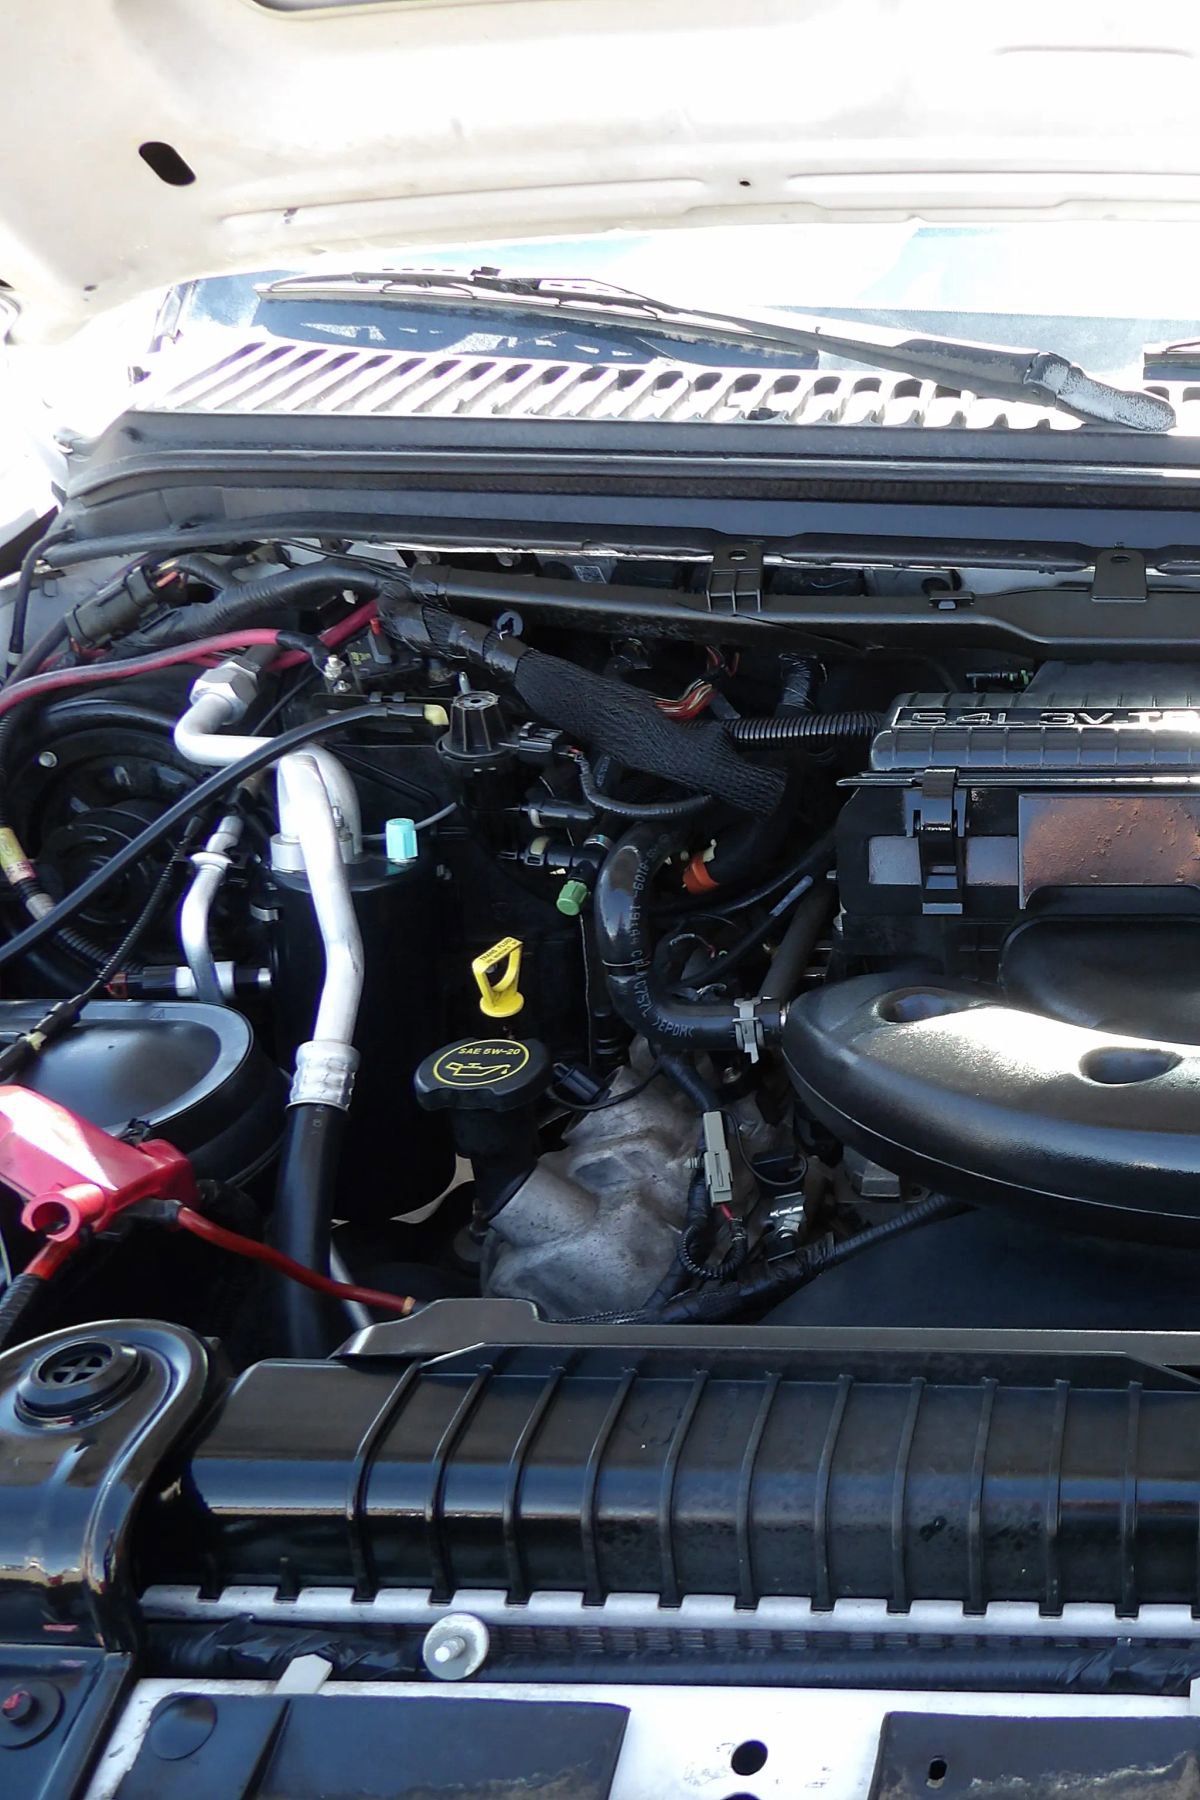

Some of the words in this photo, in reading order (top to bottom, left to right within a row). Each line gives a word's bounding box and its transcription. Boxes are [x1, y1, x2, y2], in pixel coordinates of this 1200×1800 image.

[910, 711, 1025, 726] 5.4L
[458, 1047, 481, 1056] SAE
[482, 1047, 522, 1056] 5W-20
